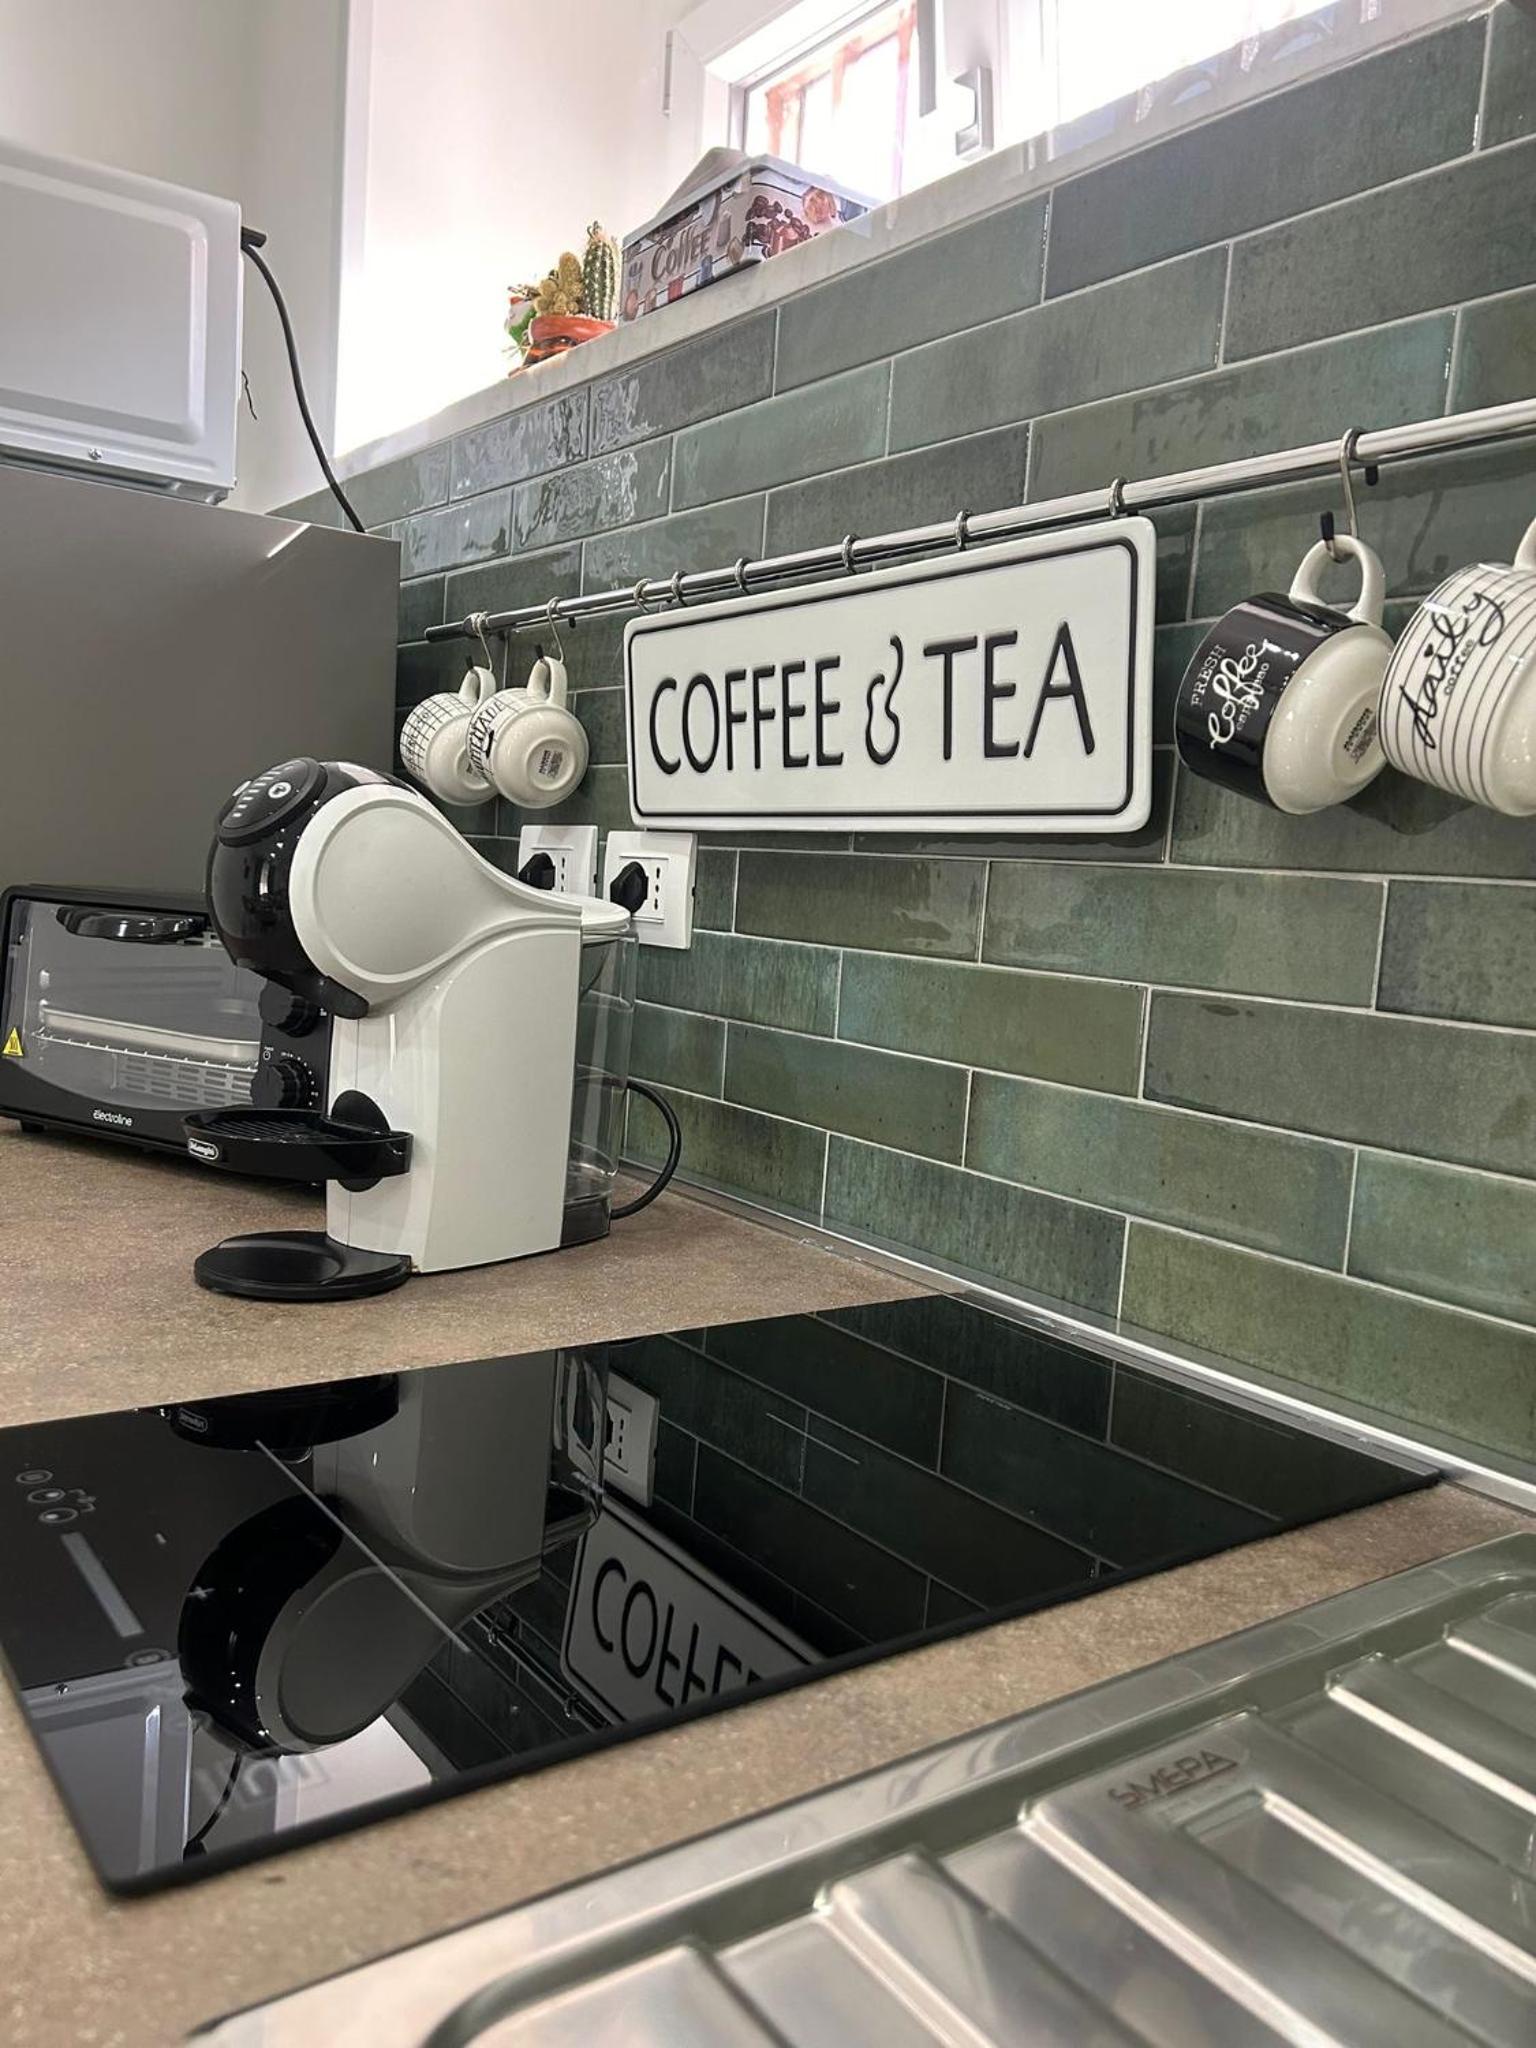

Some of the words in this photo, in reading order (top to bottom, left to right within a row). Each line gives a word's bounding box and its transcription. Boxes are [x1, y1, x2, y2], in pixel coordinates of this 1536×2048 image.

[649, 655, 844, 775] COFFEE
[864, 635, 902, 766] &
[923, 620, 1096, 761] TEA
[1190, 644, 1226, 708] FRESH
[1107, 1750, 1238, 1811] SMEPA
